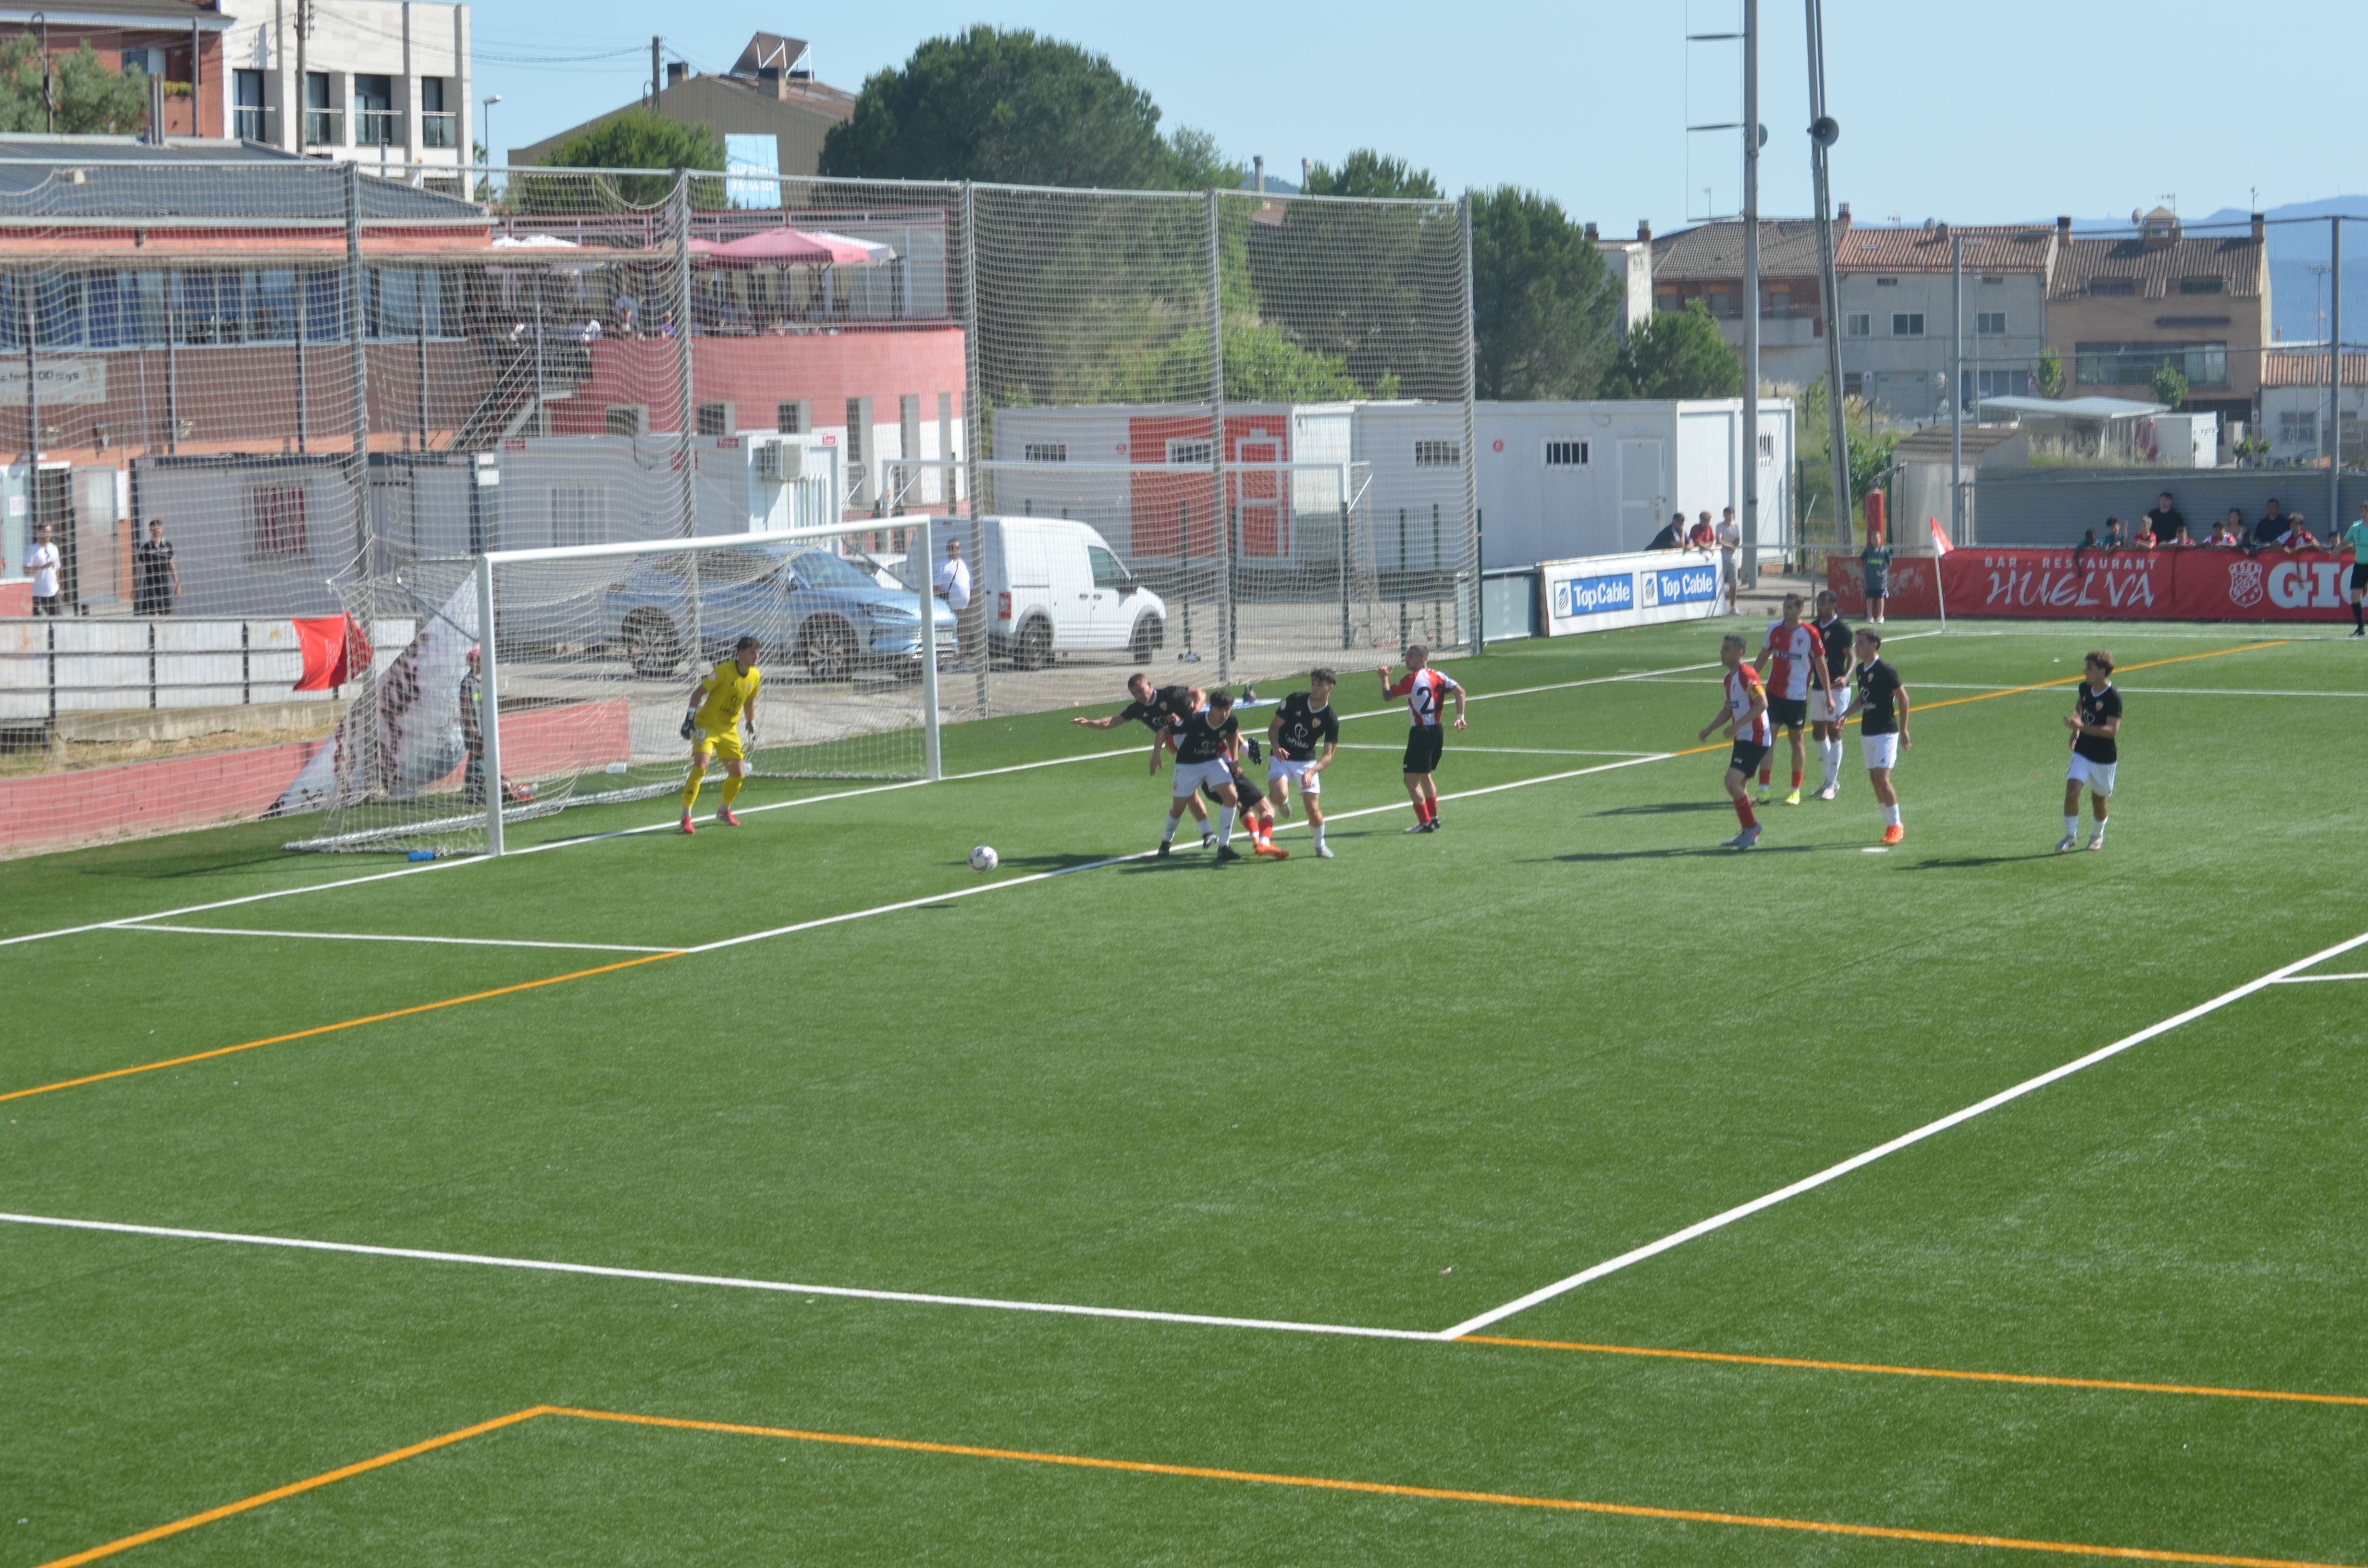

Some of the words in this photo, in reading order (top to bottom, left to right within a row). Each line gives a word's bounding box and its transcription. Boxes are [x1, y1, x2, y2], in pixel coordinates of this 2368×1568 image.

[1985, 556, 2017, 568] BAR
[2042, 557, 2156, 570] RESTAURANT
[1661, 575, 1680, 601] Top
[1682, 572, 1713, 595] Cable
[1986, 569, 2155, 608] HUELVA
[1417, 686, 1434, 714] 2
